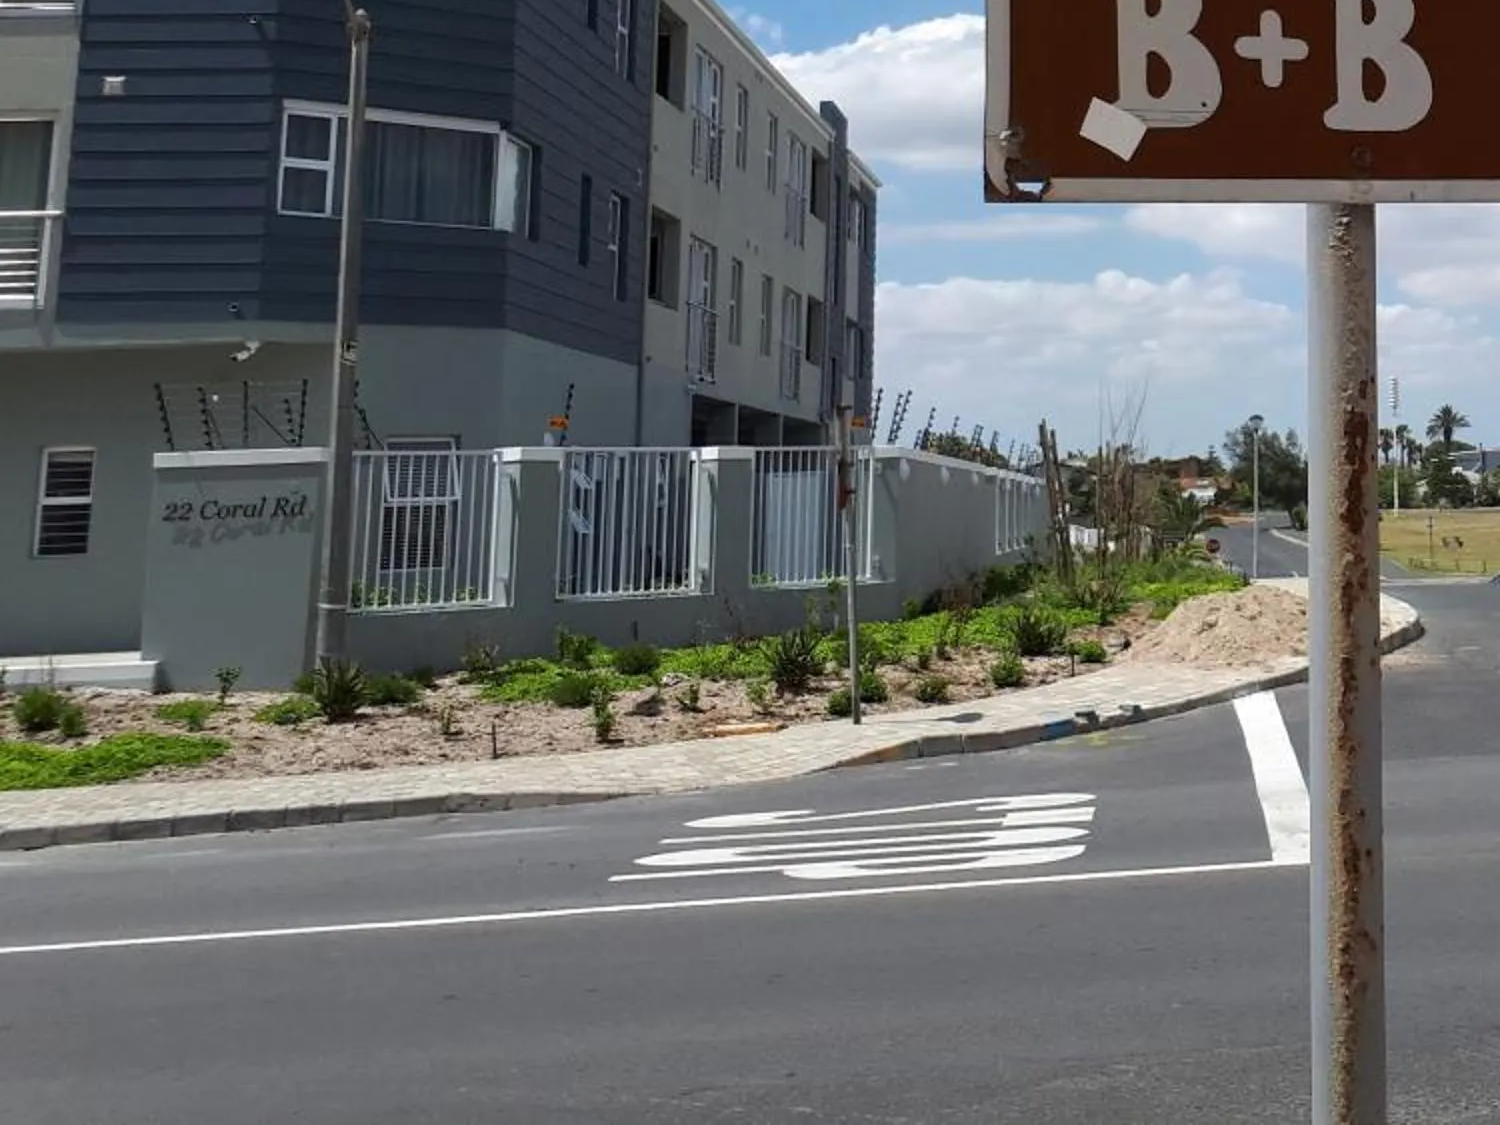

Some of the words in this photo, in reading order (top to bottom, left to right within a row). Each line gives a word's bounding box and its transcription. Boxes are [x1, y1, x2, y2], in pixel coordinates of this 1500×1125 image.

[162, 502, 193, 522] 22
[200, 496, 267, 520] Coral
[270, 493, 307, 519] Rd
[608, 792, 1097, 882] STOP
